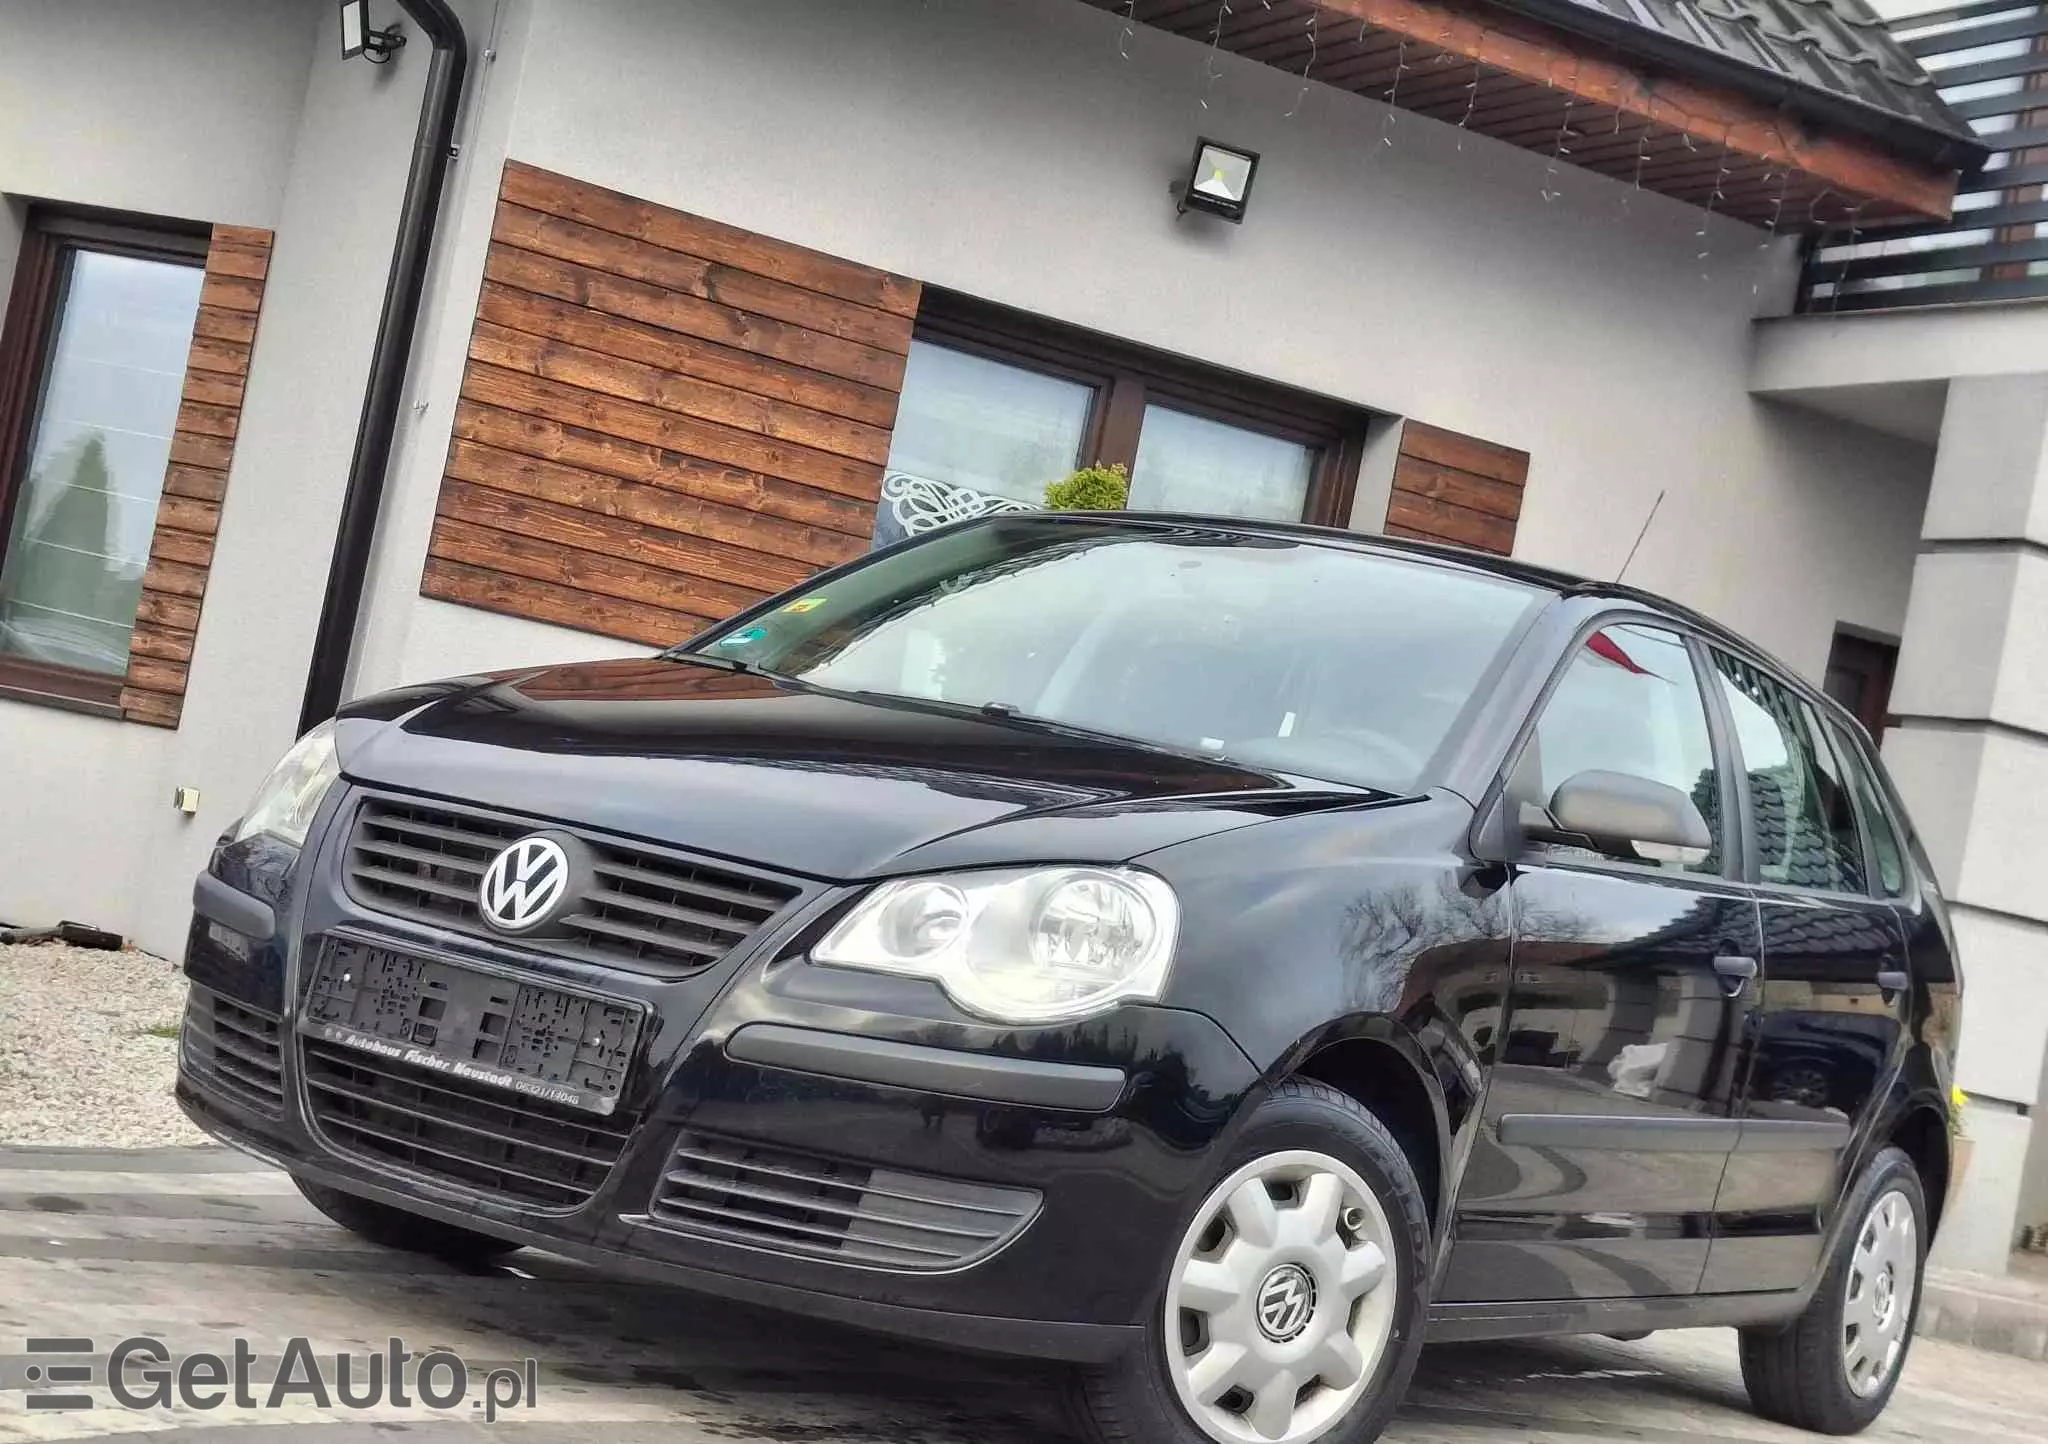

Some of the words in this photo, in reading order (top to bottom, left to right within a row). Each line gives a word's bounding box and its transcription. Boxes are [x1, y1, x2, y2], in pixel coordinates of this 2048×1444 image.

[481, 837, 568, 929] VW
[345, 1034, 402, 1057] Autohaus
[404, 1049, 451, 1070] Fischer
[453, 1062, 514, 1087] Neustadt
